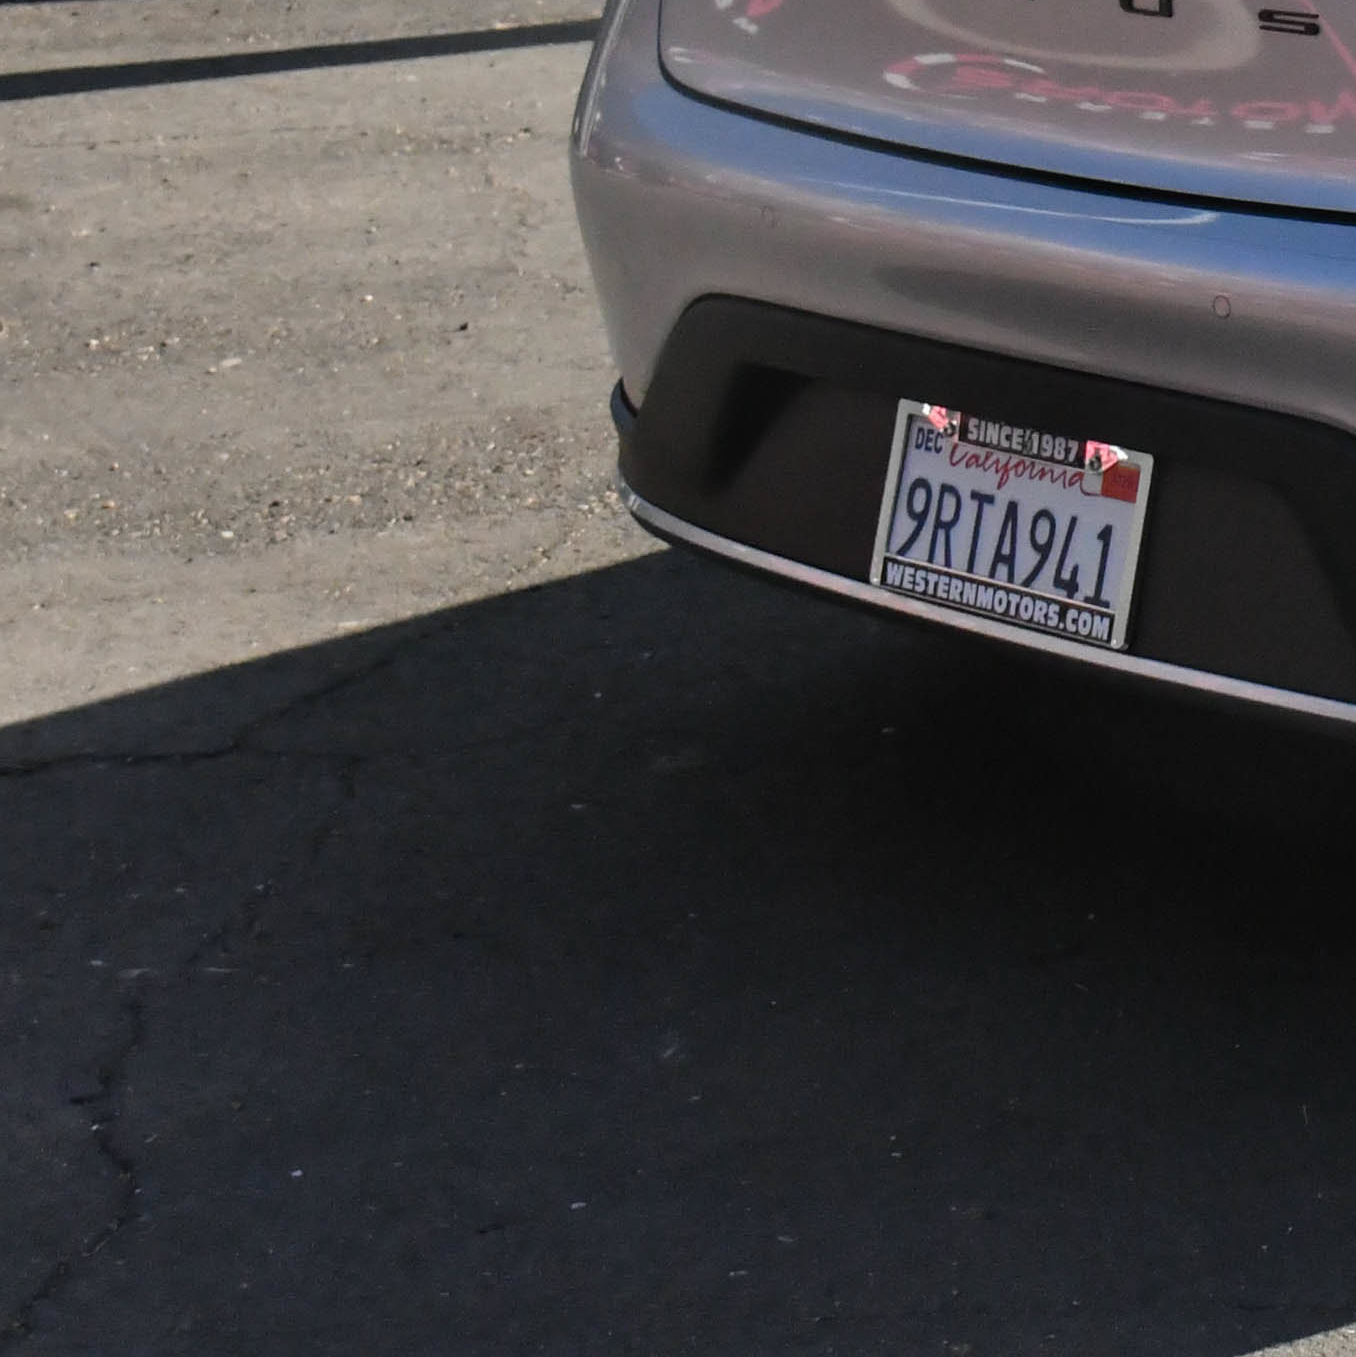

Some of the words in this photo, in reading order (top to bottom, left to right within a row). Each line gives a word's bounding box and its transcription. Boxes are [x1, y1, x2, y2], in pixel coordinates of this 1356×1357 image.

[915, 426, 945, 454] DEC
[967, 417, 1024, 452] SINCE
[1030, 431, 1079, 462] 1987
[948, 442, 1100, 496] California
[896, 477, 1114, 608] 9RTA941
[885, 564, 1110, 641] WESTERNMOTORS.COM
